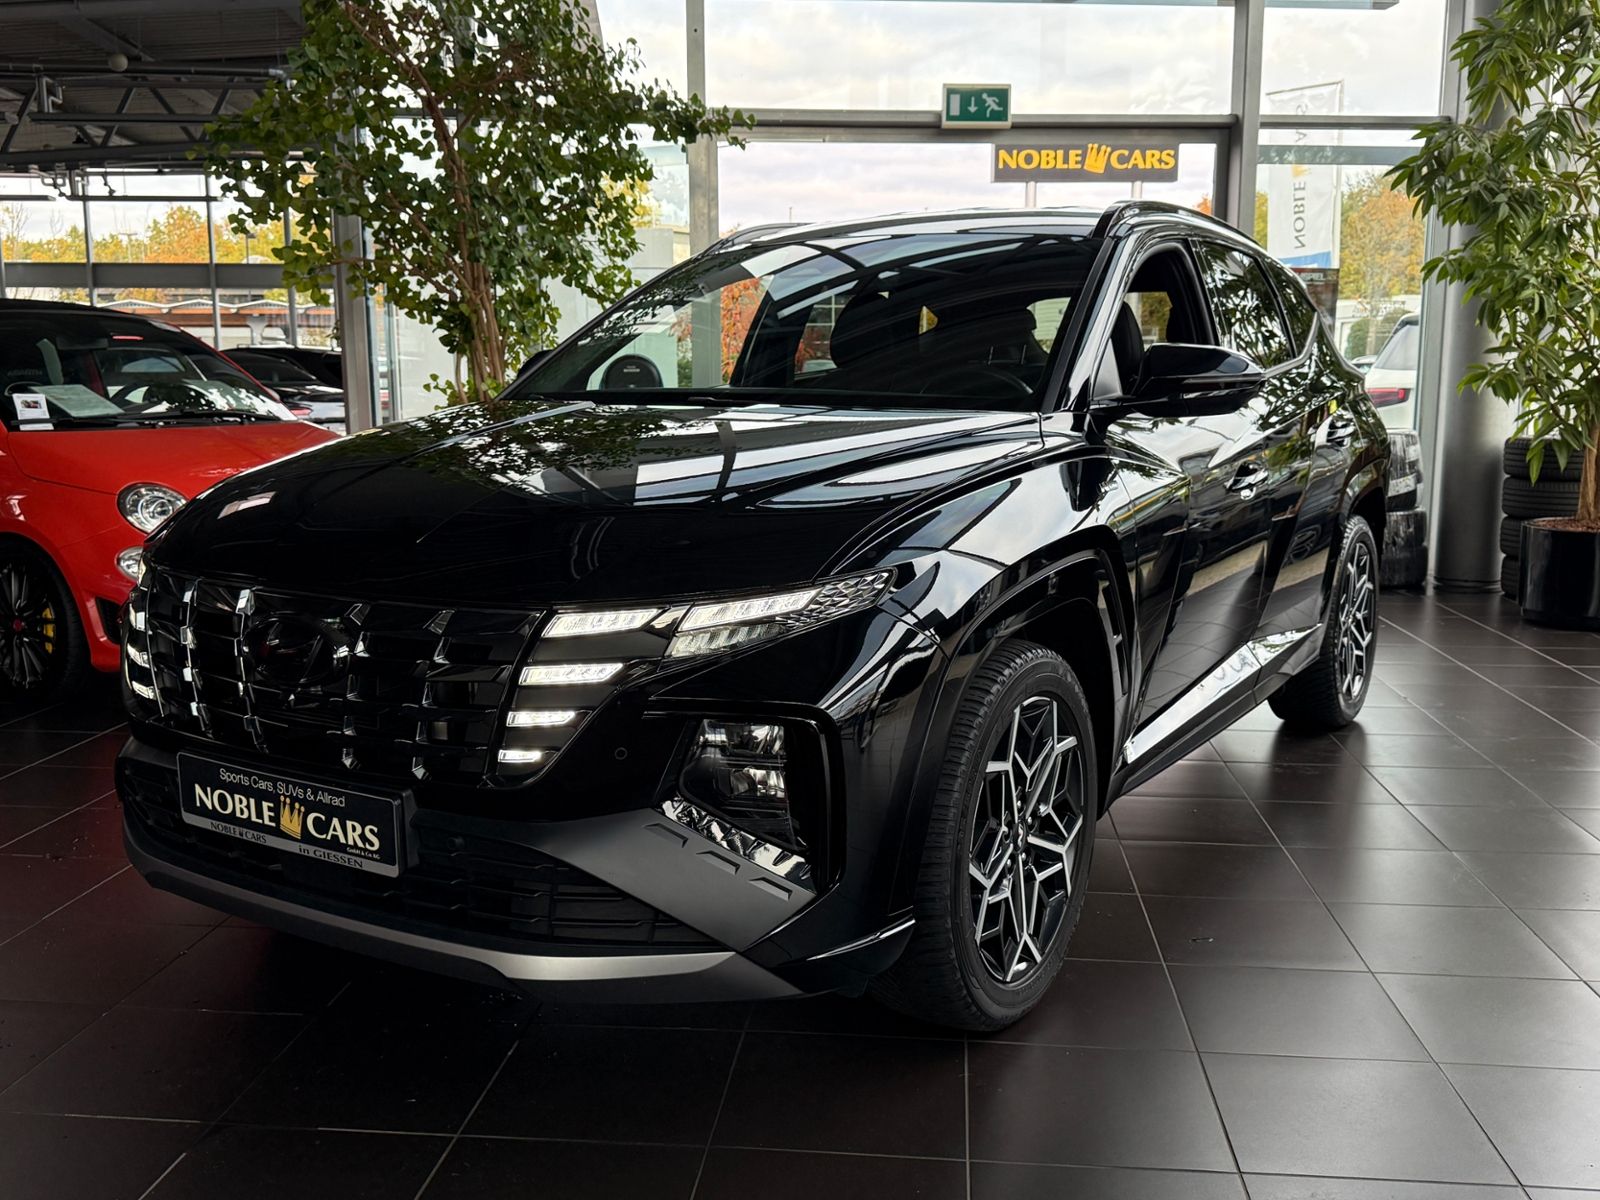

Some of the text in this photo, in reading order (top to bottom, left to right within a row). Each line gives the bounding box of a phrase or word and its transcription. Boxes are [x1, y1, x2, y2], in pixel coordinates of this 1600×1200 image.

[998, 149, 1175, 170] NOBLE CARS
[219, 767, 345, 808] Sports Cars, SUVs & Allrad
[194, 783, 380, 852] NOBLE CARS
[210, 821, 267, 844] NOBLE CARS
[298, 845, 363, 868] in GIESSEN
